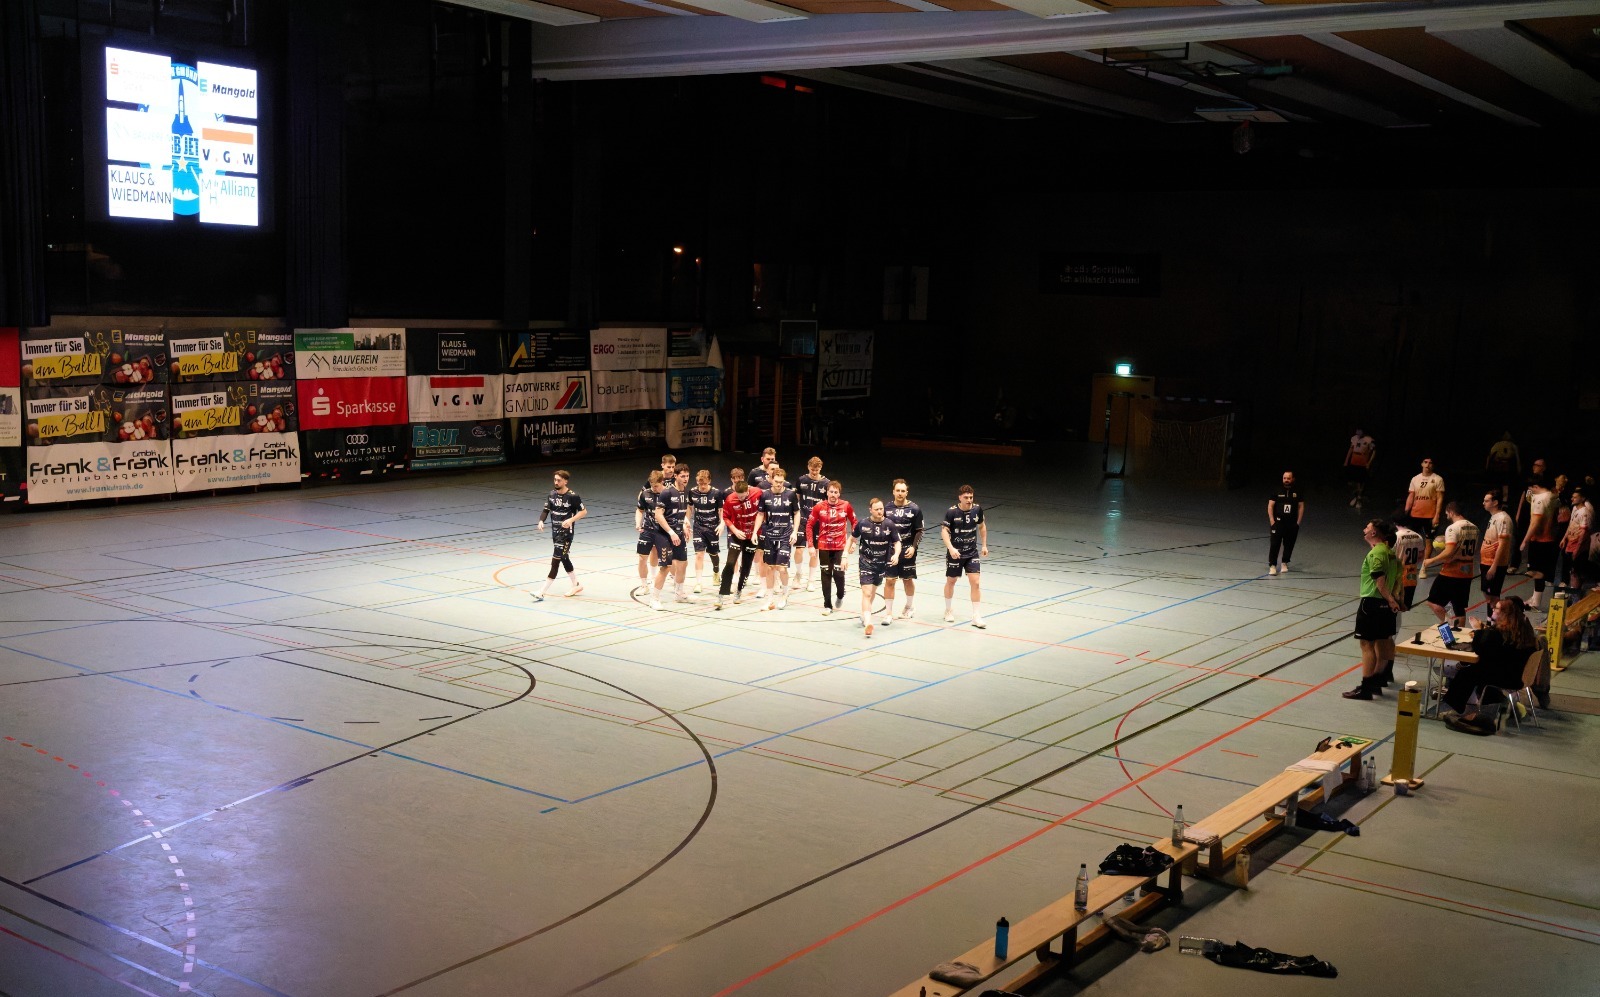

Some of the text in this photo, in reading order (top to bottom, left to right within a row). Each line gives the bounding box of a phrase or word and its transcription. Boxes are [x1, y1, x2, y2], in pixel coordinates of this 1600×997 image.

[212, 83, 255, 99] Mangold
[110, 169, 155, 186] KLAUS &
[111, 187, 172, 205] WIEDMANN
[220, 180, 256, 198] Allianz
[124, 333, 164, 342] Mangold
[257, 333, 292, 341] Mangold
[441, 340, 468, 348] KLAUS &
[25, 341, 82, 355] Immer für Sie
[173, 342, 197, 353] Immer
[198, 340, 208, 351] für
[210, 339, 222, 350] Sie
[441, 348, 476, 357] WIEDMANN
[593, 344, 615, 355] ERGO
[36, 354, 97, 379] am Ball!
[181, 352, 235, 375] am Ball!
[332, 354, 379, 365] BAUVEREIN
[260, 386, 292, 394] Mangold
[505, 381, 560, 393] STADTWERKE
[125, 390, 164, 399] Mangold
[30, 399, 87, 414] Immer für Sie
[174, 398, 199, 409] Immer
[200, 396, 211, 407] für
[213, 395, 224, 405] Sie
[336, 399, 396, 418] Sparkasse
[505, 396, 549, 413] GMÜND
[40, 424, 59, 435] am
[62, 410, 101, 436] Ball!
[184, 419, 202, 428] am
[540, 420, 576, 436] Allianz
[411, 426, 459, 448] Baur
[175, 445, 298, 468] Frank & Frank
[314, 445, 397, 459] WWG AUTOWELT
[30, 453, 169, 477] Frank & Frank
[1419, 481, 1428, 489] 27
[700, 495, 708, 505] 19
[773, 497, 782, 507] 24
[830, 509, 837, 518] 12
[894, 508, 904, 518] 30
[1284, 505, 1291, 513] A
[965, 514, 971, 524] 5
[874, 526, 880, 536] 3
[1404, 547, 1418, 566] 20
